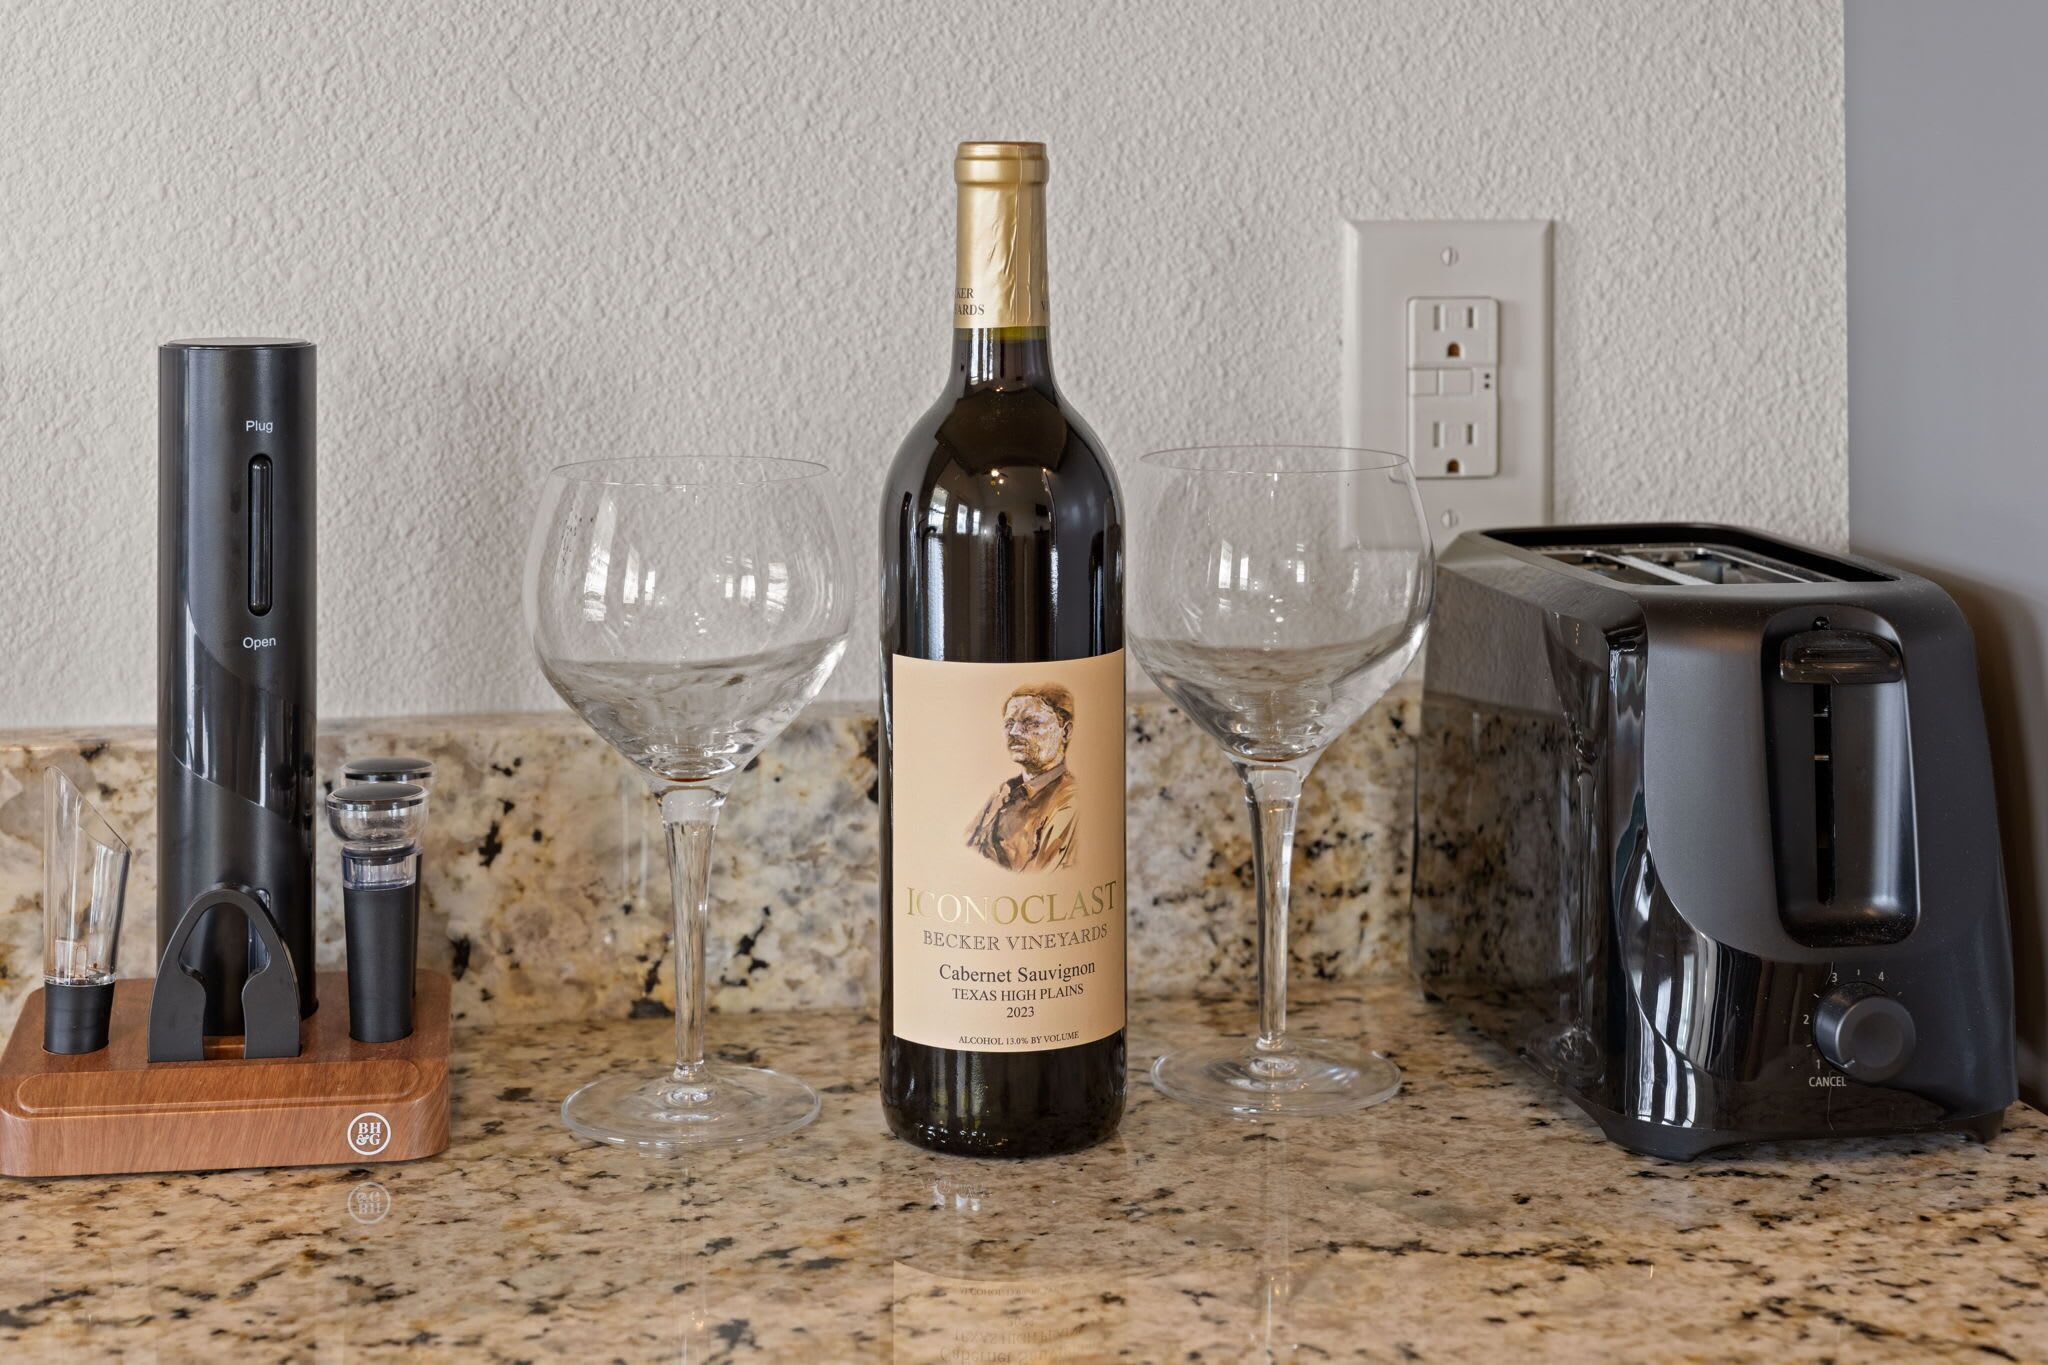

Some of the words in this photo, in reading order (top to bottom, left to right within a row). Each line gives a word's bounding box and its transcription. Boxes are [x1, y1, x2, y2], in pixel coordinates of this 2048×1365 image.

[245, 420, 274, 434] Plug
[242, 636, 277, 651] Open
[906, 880, 1117, 925] ICONOCLAST
[923, 929, 1001, 951] BECKER
[1006, 923, 1108, 951] VINEYARDS
[939, 963, 1011, 983] Cabernet
[1017, 960, 1096, 984] Sauvignon
[1831, 972, 1838, 983] 3
[1878, 971, 1885, 982] 4
[952, 987, 997, 1002] TEXAS
[1001, 989, 1037, 1002] HIGH
[1040, 983, 1084, 1001] PLAINS
[1006, 1006, 1035, 1018] 2023
[1803, 1014, 1810, 1025] 2
[958, 1035, 1004, 1046] ALCOHOL
[1006, 1036, 1029, 1046] 13.0%
[1031, 1035, 1043, 1045] BY
[1043, 1030, 1080, 1044] VOLUME
[1816, 1059, 1821, 1070] 1
[1808, 1076, 1847, 1088] CANCEL
[358, 1121, 382, 1134] BH
